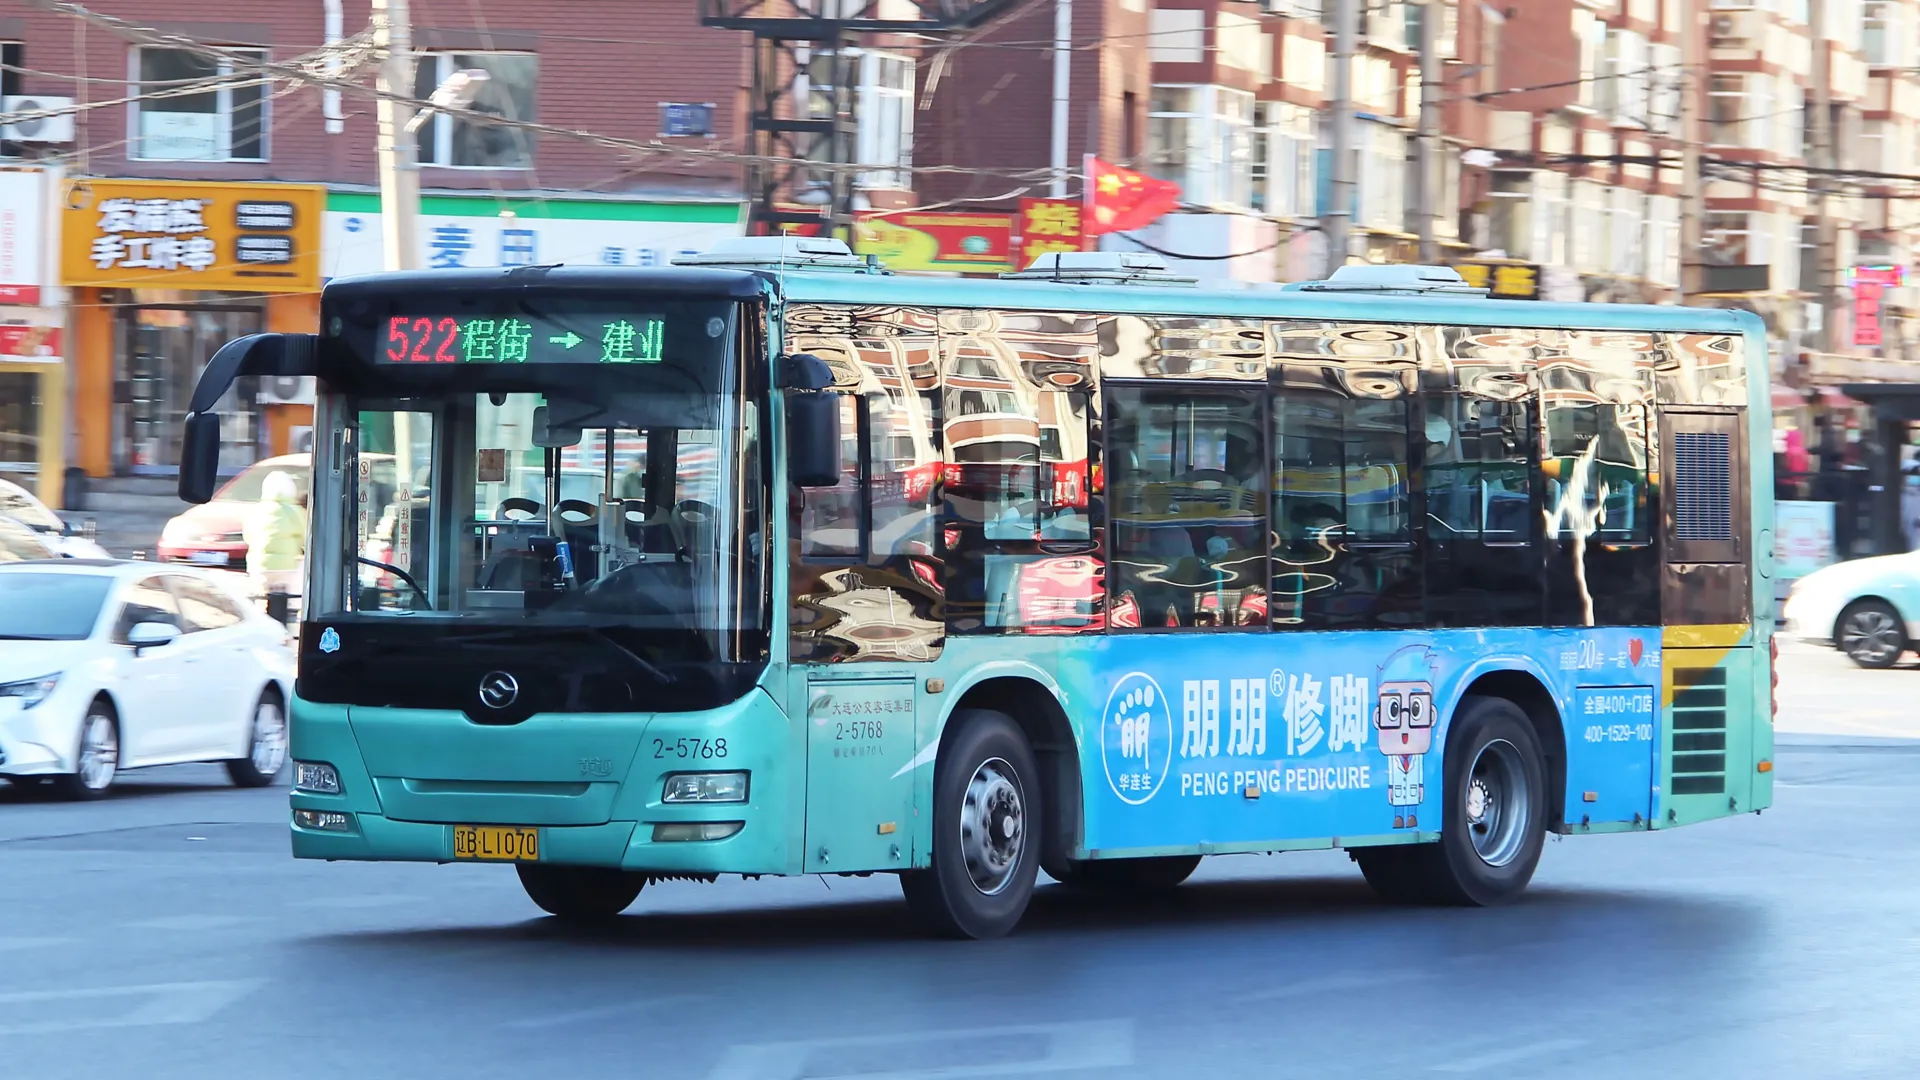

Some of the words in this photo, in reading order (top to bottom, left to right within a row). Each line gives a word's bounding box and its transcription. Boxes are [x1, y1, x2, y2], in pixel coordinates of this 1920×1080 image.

[387, 316, 458, 362] 522
[401, 508, 409, 564] 注意开门
[1641, 650, 1661, 668] 大连
[832, 699, 913, 716] 大连公交客运集团
[1584, 694, 1653, 715] 全国400+门店
[835, 720, 883, 741] 2-5768
[1584, 723, 1653, 743] 400-1529-100
[652, 737, 728, 760] 2-5768
[1119, 772, 1152, 791] 华连生
[1181, 771, 1229, 797] PENG
[1233, 768, 1281, 795] PENG
[1286, 765, 1371, 792] PEDICURE
[456, 830, 536, 856] 辽B·L1070
